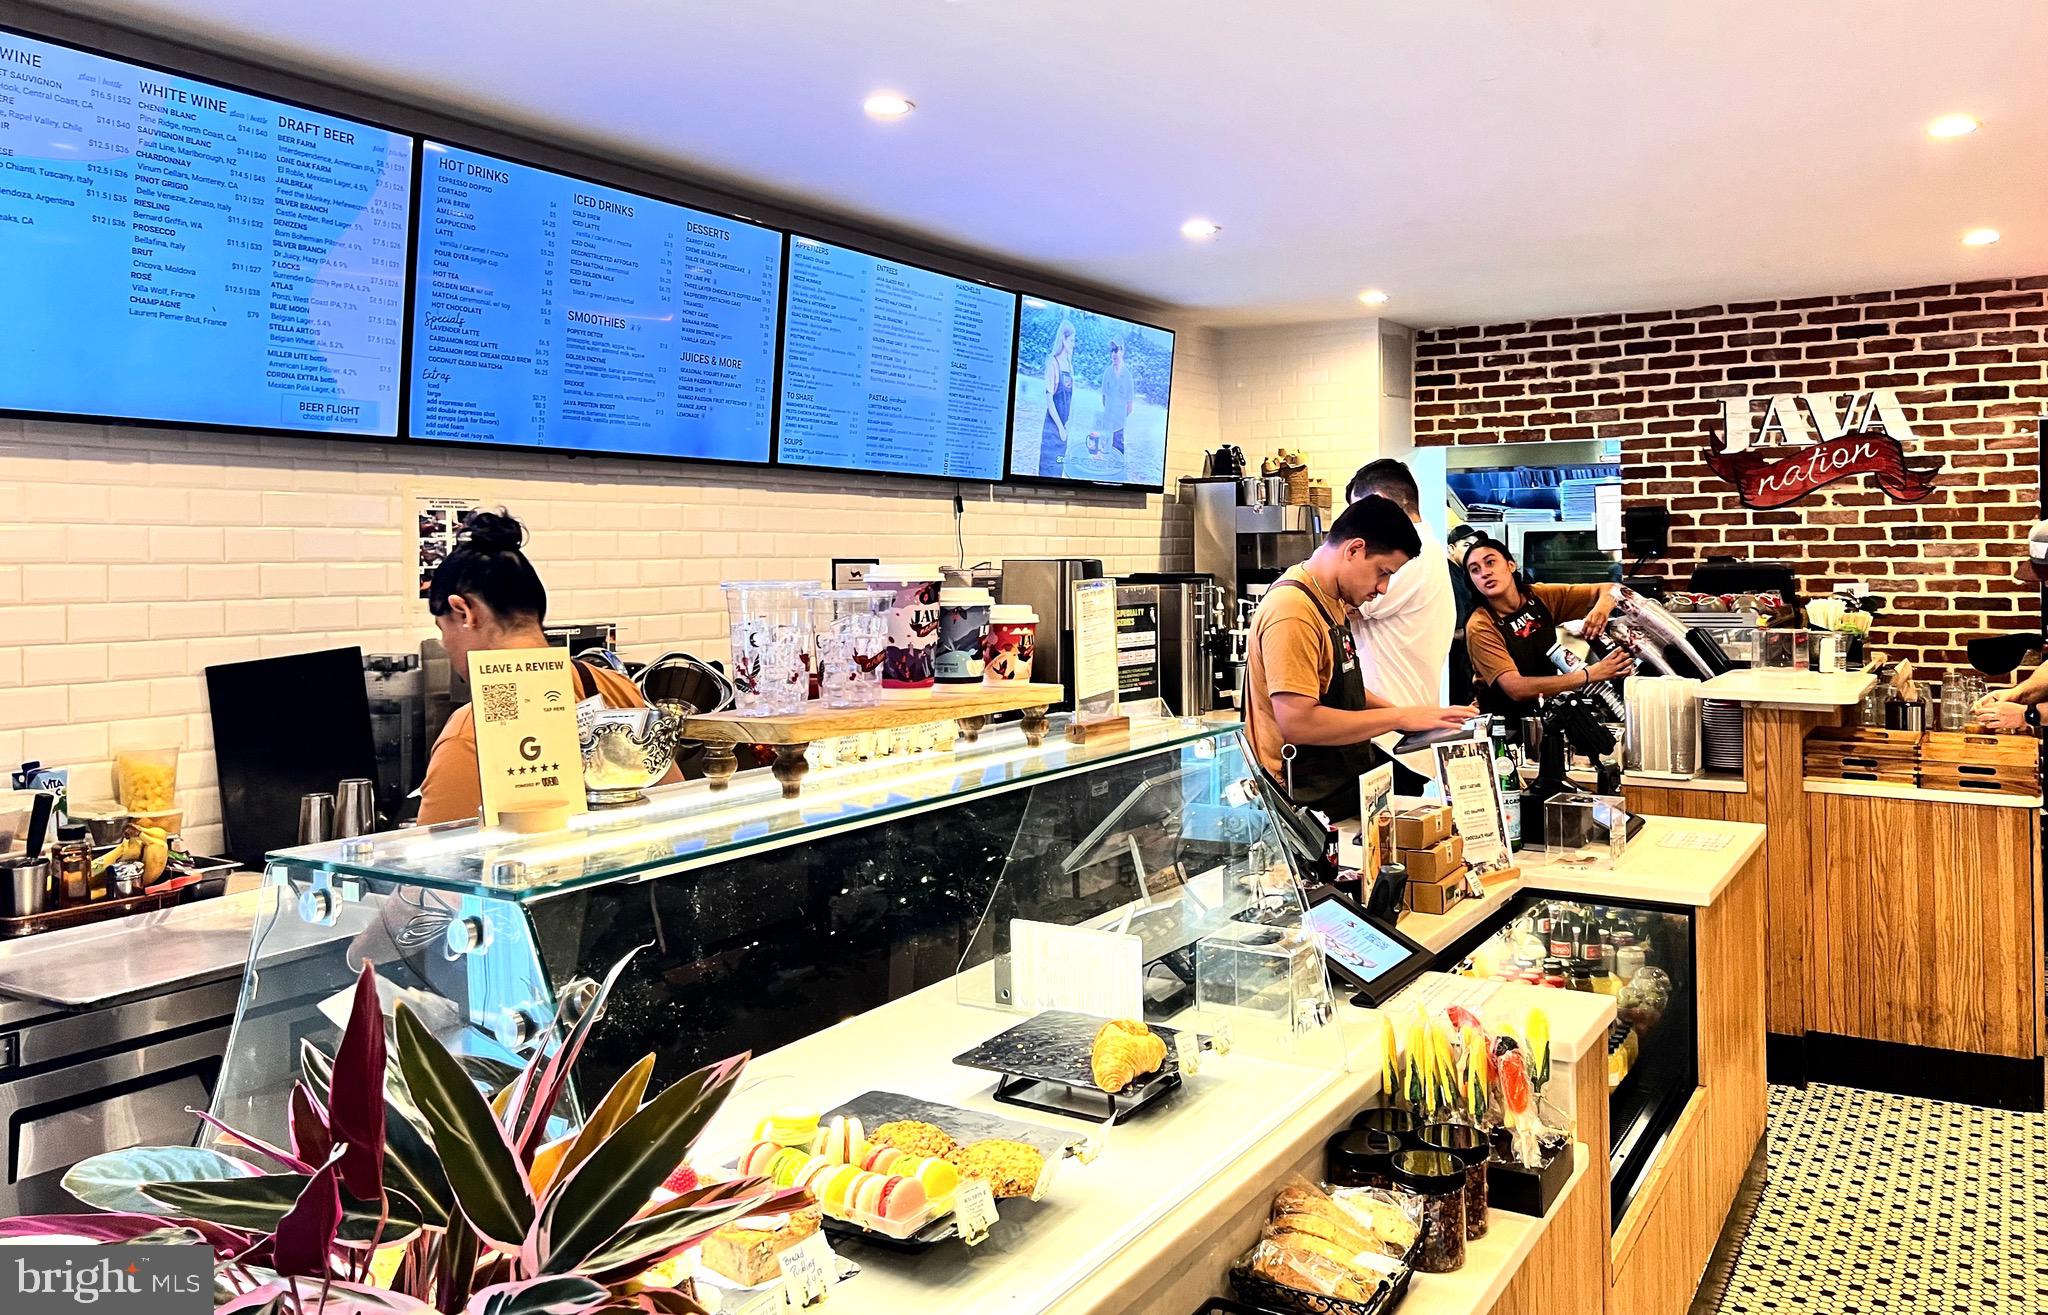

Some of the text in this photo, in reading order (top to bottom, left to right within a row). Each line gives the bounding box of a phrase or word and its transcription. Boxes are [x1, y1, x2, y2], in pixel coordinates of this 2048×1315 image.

[0, 46, 41, 68] WINE
[10, 71, 62, 89] SAUVIGNON
[139, 80, 228, 114] WHITE WINE
[81, 100, 94, 110] CA
[138, 101, 197, 121] CHENIN BLANC
[137, 125, 212, 149] SAUVIGNON BLANC
[278, 115, 355, 145] DRAFT BEER
[226, 134, 237, 142] CA
[277, 134, 317, 149] BEER FARM
[135, 150, 192, 168] CHARDONNAY
[226, 158, 238, 167] NZ
[276, 155, 332, 174] LONE OAK FARM
[39, 167, 75, 183] Tuscany,
[76, 175, 94, 186] Italy
[439, 157, 509, 184] HOT DRINKS
[135, 174, 189, 191] PINOT GRIGIO
[227, 181, 239, 190] CA
[275, 176, 314, 190] JAILBREAK
[438, 175, 493, 194] ESPRESSO DOPPIO
[437, 186, 468, 198] CORTADO
[36, 192, 75, 207] Argentina
[133, 198, 171, 211] RIESLING
[275, 197, 329, 214] SILVER BRANCH
[436, 197, 471, 209] JAVA BREW
[574, 193, 634, 218] ICED DRINKS
[21, 216, 35, 225] CA
[133, 210, 163, 223] Bernard
[190, 222, 203, 230] WA
[273, 218, 308, 231] DENIZENS
[435, 217, 476, 231] CAPPUCCINO
[584, 222, 601, 232] LATTE
[132, 222, 176, 237] PROSECCO
[435, 228, 454, 237] LATTE
[686, 221, 730, 241] DESSERTS
[131, 247, 154, 257] BRUT
[170, 242, 186, 252] Italy
[272, 239, 327, 255] SILVER BRANCH
[795, 241, 829, 256] APPETIZERS
[434, 249, 470, 261] POUR OVER
[433, 259, 449, 268] CHAI
[876, 263, 898, 276] ENTREES
[433, 270, 460, 280] HOT TEA
[270, 281, 294, 291] ATLAS
[432, 280, 476, 294] GOLDEN MILK
[170, 289, 196, 300] France
[431, 291, 459, 301] MATCHA
[129, 295, 182, 309] CHAMPAGNE
[269, 302, 310, 314] BLUE MOON
[431, 301, 482, 315] HOT CHOCOLATE
[129, 307, 158, 318] Laurent
[203, 317, 228, 327] France
[424, 312, 466, 328] Specials
[568, 310, 626, 330] SMOOTHIES
[269, 323, 321, 336] STELLA ARTOIS
[430, 324, 481, 337] LAVENDER LATTE
[270, 334, 294, 344] Belgian
[464, 338, 499, 350] ROSE LATTE
[267, 349, 309, 362] MILLER LITE
[428, 355, 504, 370] COCONUT CLOUD MATCHA
[463, 349, 532, 364] ROSE CREAM COLD BREW
[680, 351, 742, 370] JUICES & MORE
[268, 361, 300, 371] American
[266, 371, 319, 383] CORONA EXTRA
[422, 367, 452, 384] Extras
[268, 381, 296, 391] Mexican
[786, 391, 814, 402] TO SHARE
[868, 393, 888, 403] PASTAS
[299, 402, 360, 416] BEER FLIGHT
[325, 414, 334, 422] of
[1717, 391, 1921, 455] JAVA
[783, 437, 803, 446] SOUPS
[1757, 442, 1878, 496] nation
[1509, 612, 1535, 632] JAVA
[479, 661, 564, 675] LEAVE A REVIEW
[519, 736, 541, 761] G
[43, 778, 64, 790] VITA
